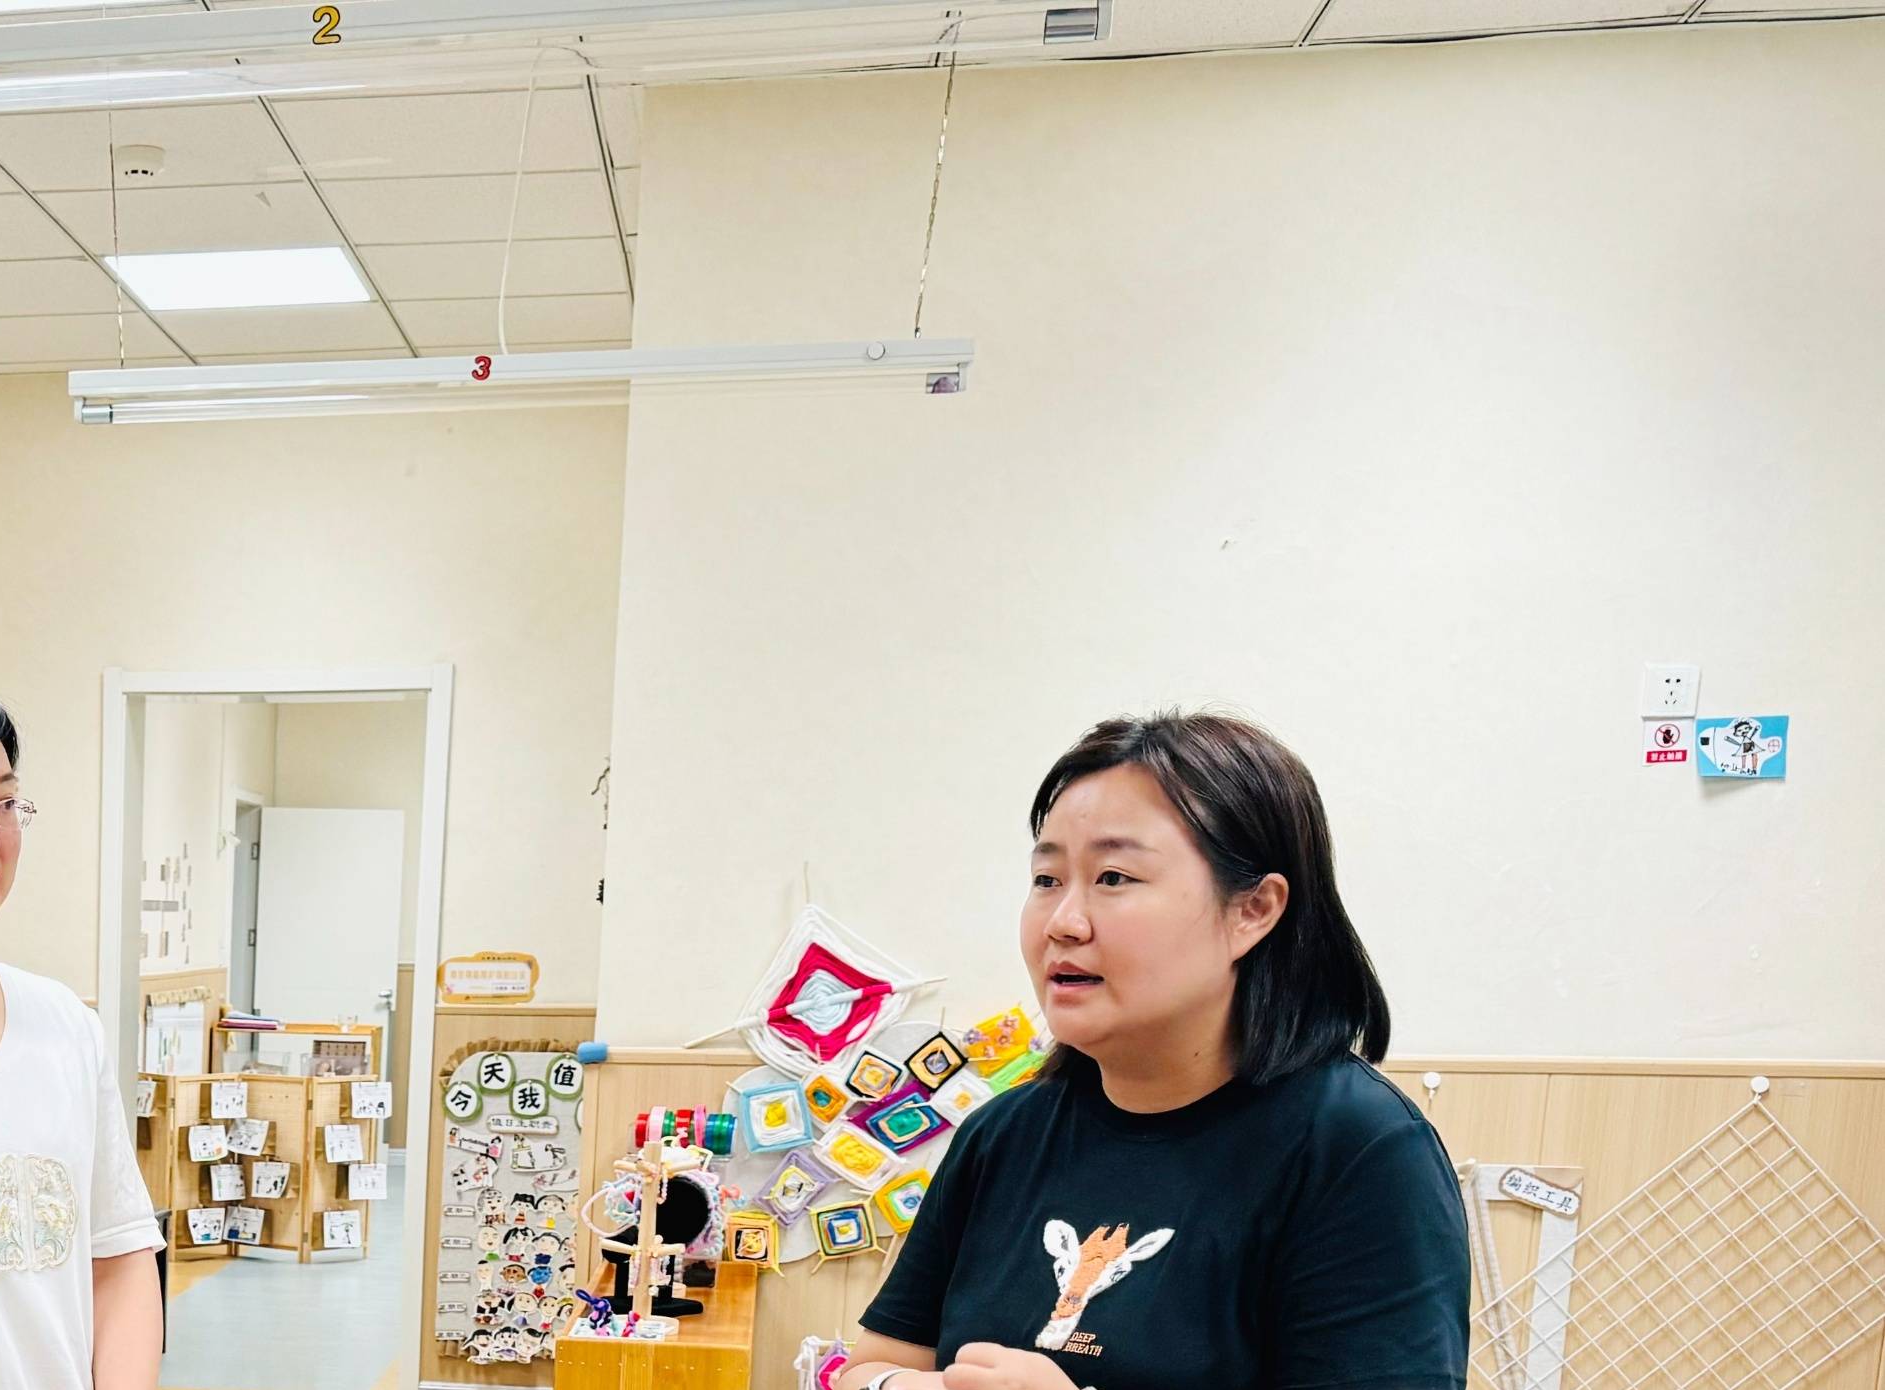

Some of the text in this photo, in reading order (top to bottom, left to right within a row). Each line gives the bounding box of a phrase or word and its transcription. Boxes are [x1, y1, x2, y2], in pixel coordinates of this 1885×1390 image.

[313, 5, 341, 45] 2
[471, 355, 492, 381] 3
[1506, 1174, 1572, 1212] 编织工具
[1063, 1341, 1103, 1357] BREATH
[1069, 1331, 1096, 1343] DEEP
